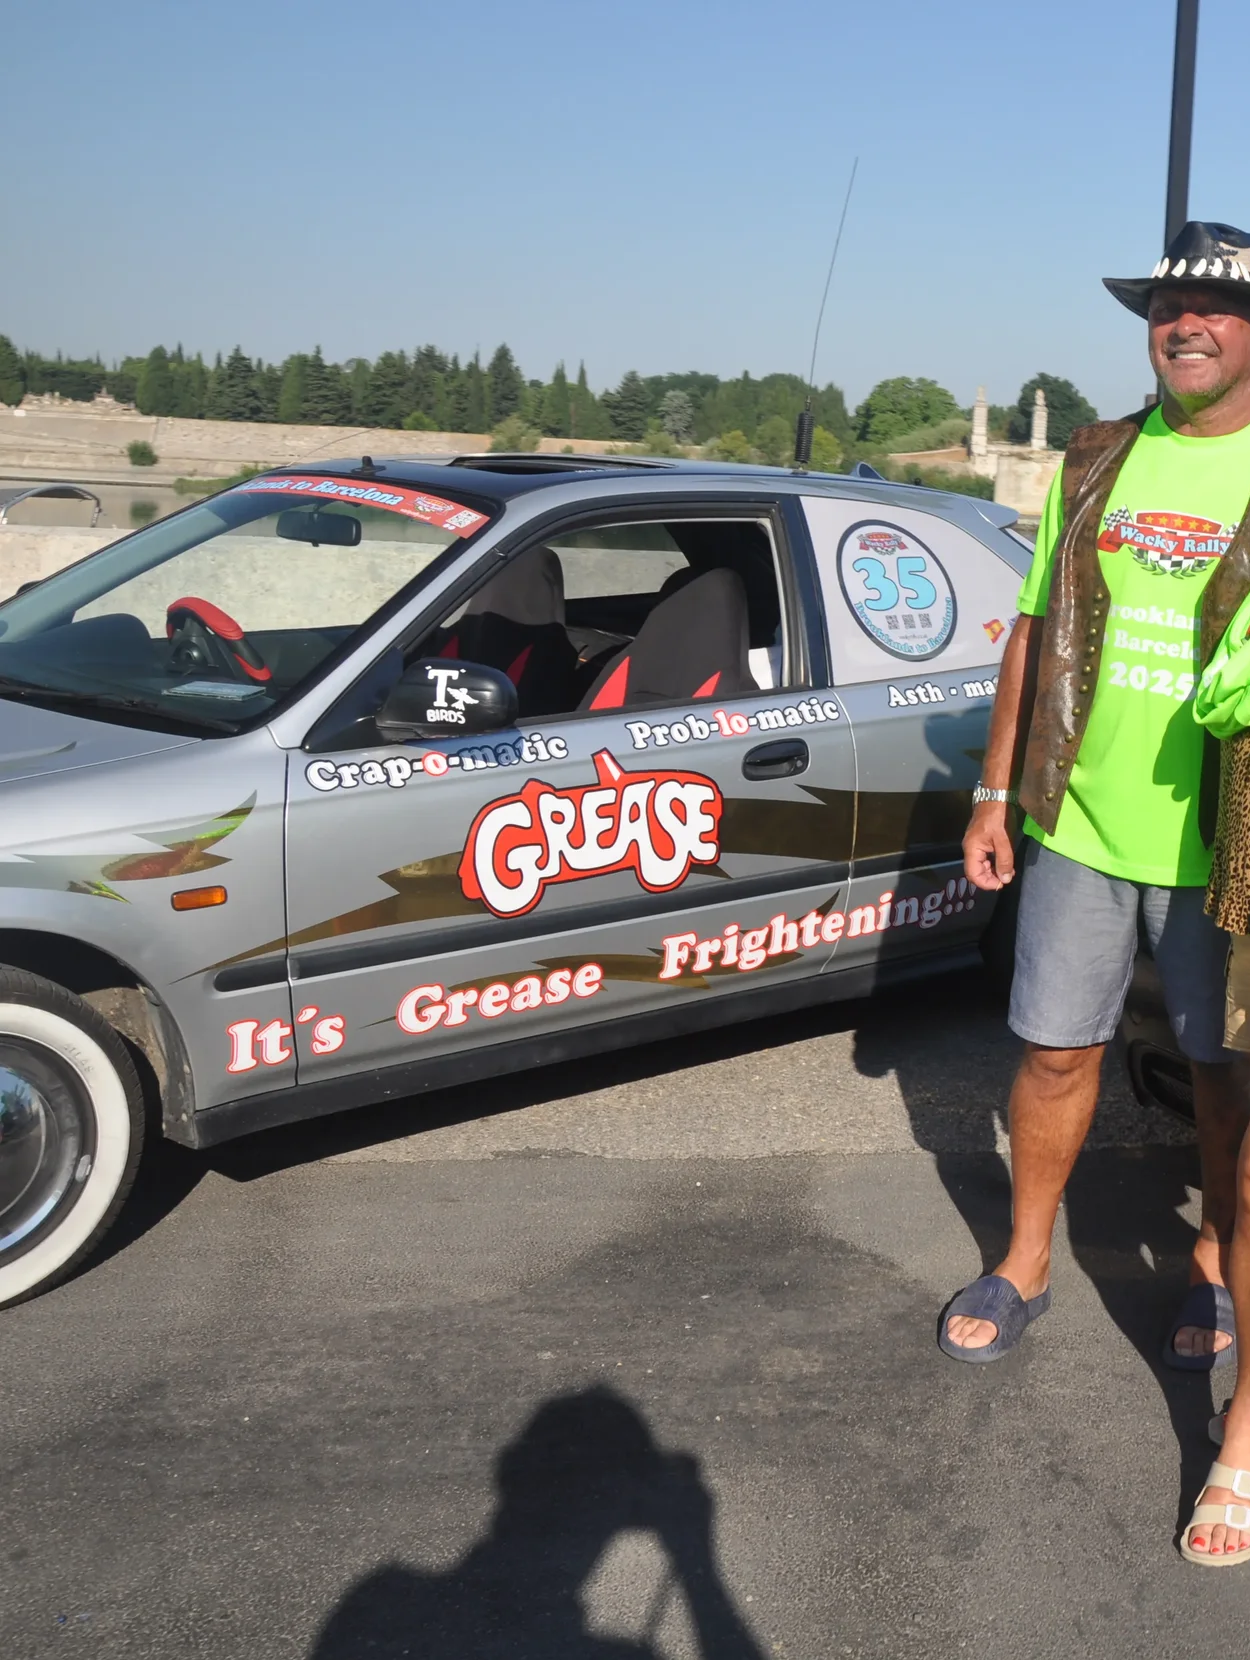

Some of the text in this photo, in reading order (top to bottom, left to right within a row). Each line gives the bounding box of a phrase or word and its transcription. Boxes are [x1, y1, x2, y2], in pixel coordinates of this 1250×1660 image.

[290, 480, 312, 490] to
[309, 481, 405, 506] Barcelona
[1120, 525, 1230, 555] Wacky Rally
[852, 557, 936, 611] 35
[1109, 604, 1201, 631] rooklan
[1113, 628, 1200, 661] Barcelo
[887, 681, 946, 708] Asth
[1108, 661, 1200, 702] 2025
[426, 709, 466, 724] BIRDS
[625, 697, 840, 750] Prob-lo-matic
[305, 732, 569, 792] Crap-o-matic
[474, 778, 718, 914] GREASE
[226, 1004, 346, 1074] It's
[396, 962, 603, 1035] Grease
